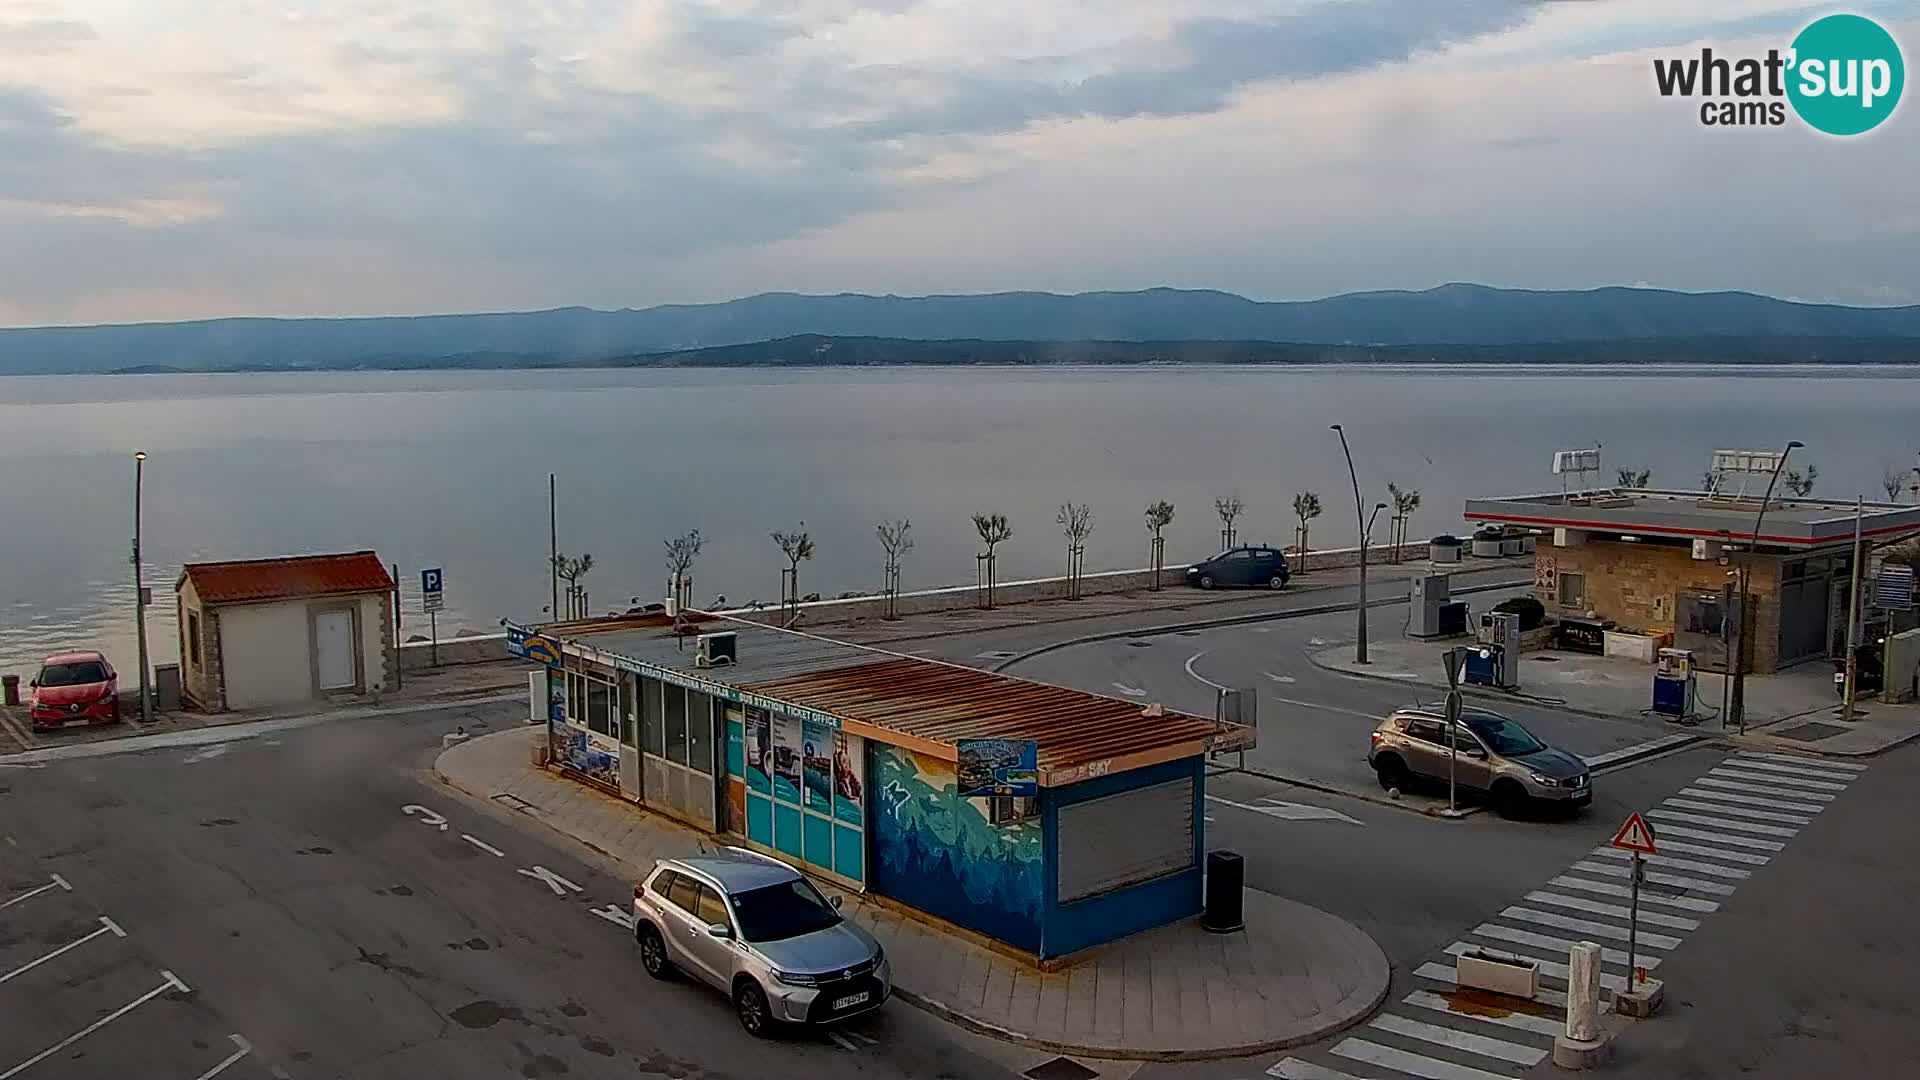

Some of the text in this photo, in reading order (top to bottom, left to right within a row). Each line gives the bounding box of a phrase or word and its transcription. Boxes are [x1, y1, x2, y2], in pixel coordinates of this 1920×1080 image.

[426, 572, 438, 589] P
[739, 692, 753, 705] BUS
[754, 697, 784, 712] STATION
[786, 705, 811, 720] TICKET
[812, 713, 838, 727] OFFICE
[1088, 759, 1112, 777] SKY
